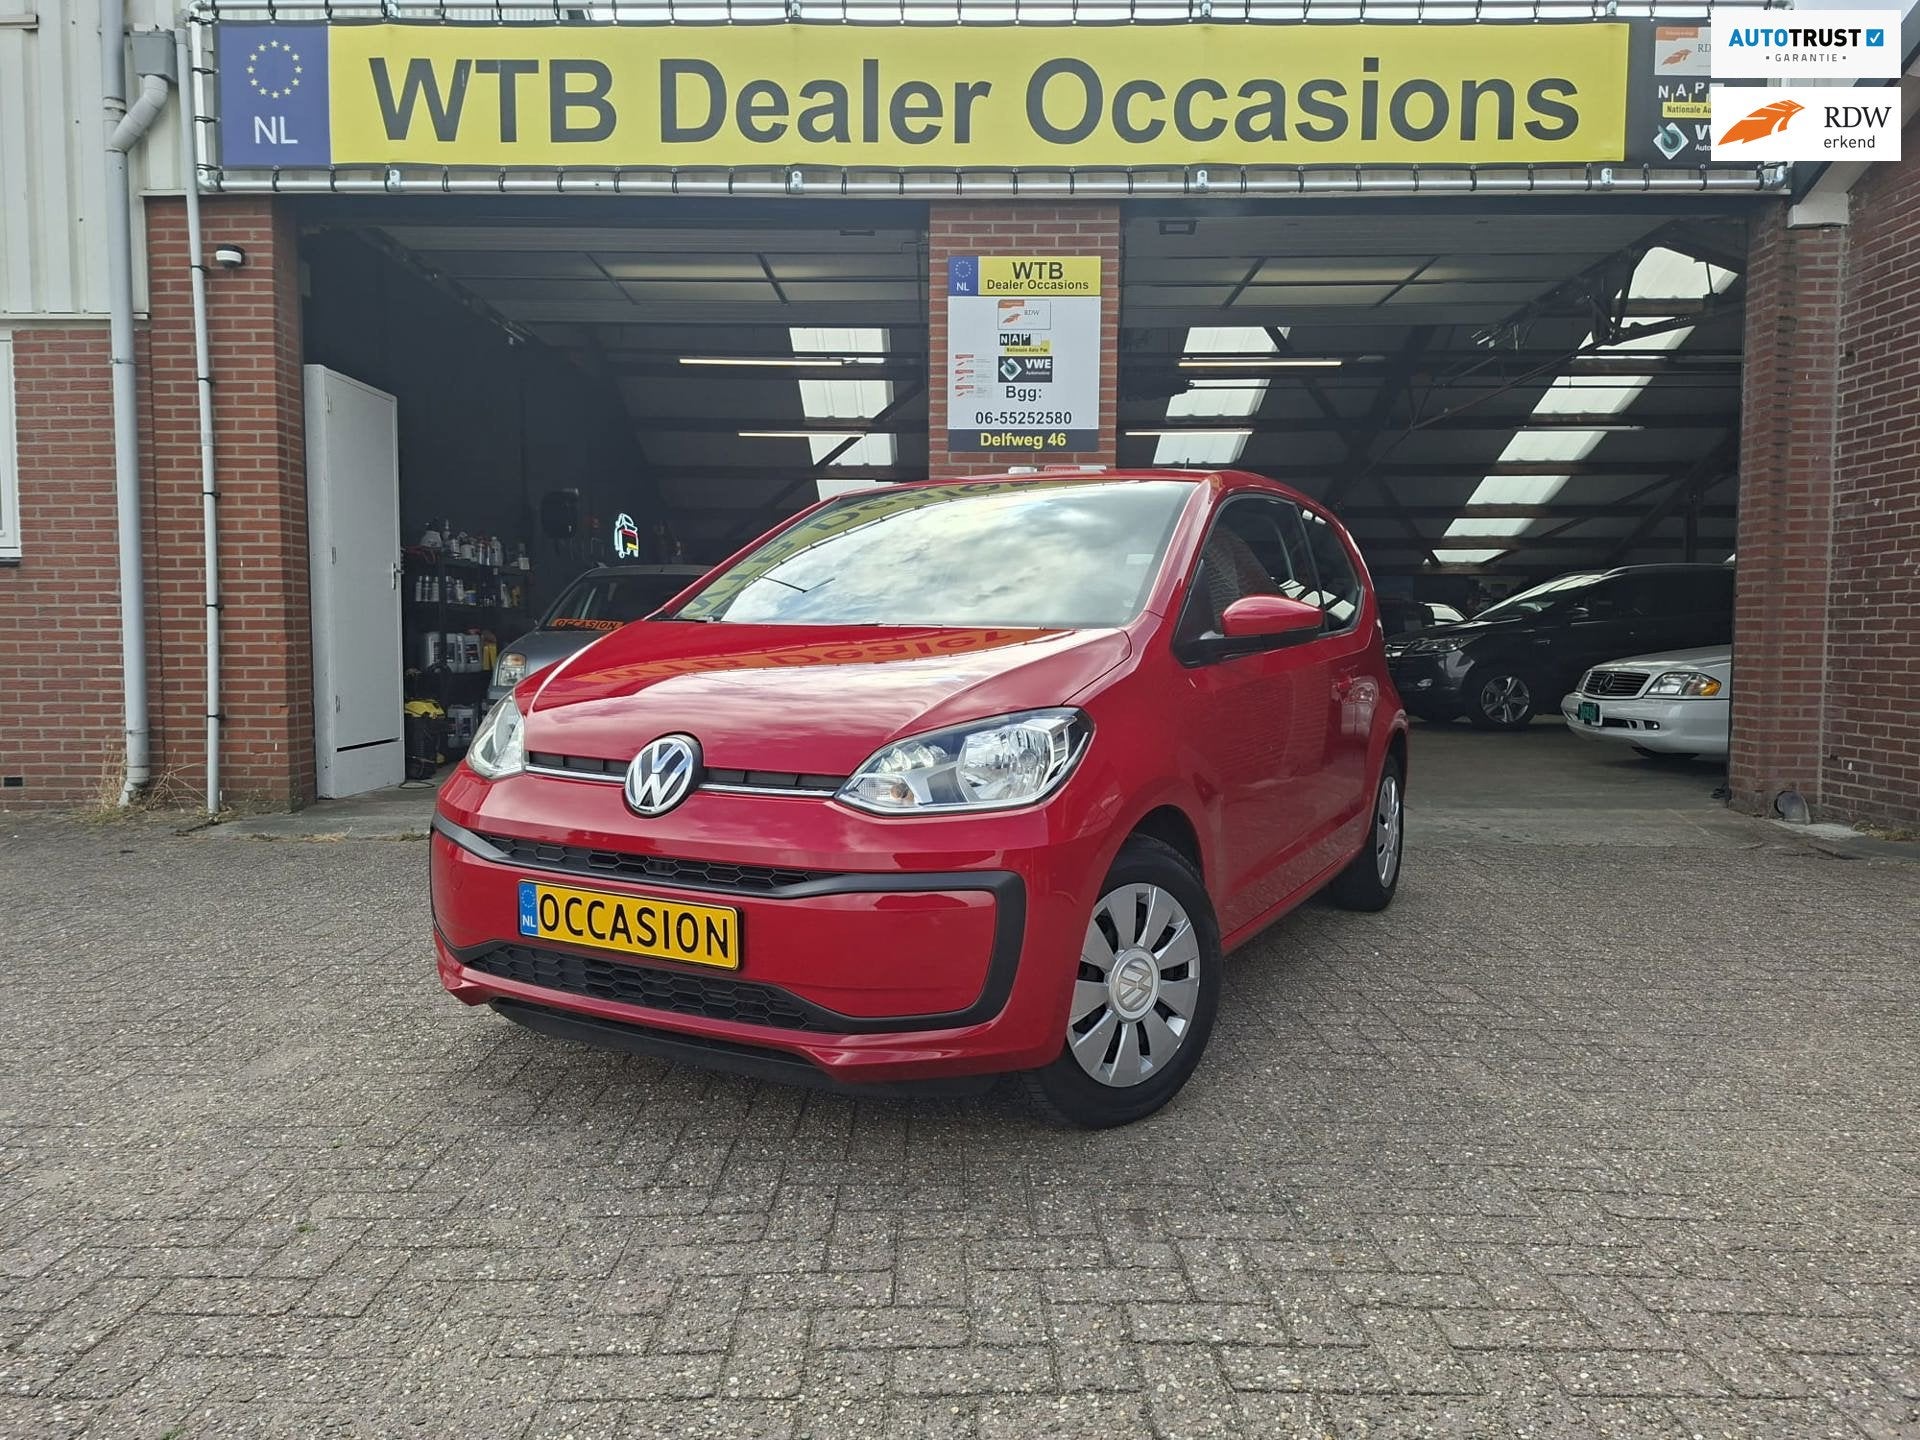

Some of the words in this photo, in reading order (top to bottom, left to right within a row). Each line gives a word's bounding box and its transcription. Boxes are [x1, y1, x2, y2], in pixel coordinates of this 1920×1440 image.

[368, 57, 619, 144] WTB
[659, 57, 991, 144] Dealer
[1025, 56, 1580, 145] Occasions
[1666, 105, 1701, 114] Nationale
[254, 116, 298, 144] NL
[1012, 261, 1064, 280] WTB
[956, 281, 970, 292] NL
[986, 279, 1024, 290] Dealer
[1027, 279, 1089, 290] Occasions
[1025, 358, 1052, 369] VWE
[1005, 385, 1043, 401] Bgg:
[975, 411, 1072, 425] 06-55252580
[980, 432, 1044, 448] Delfweg
[1047, 432, 1067, 447] 46
[556, 619, 618, 630] OCCASION
[522, 915, 537, 928] NL
[539, 893, 729, 959] OCCASION
